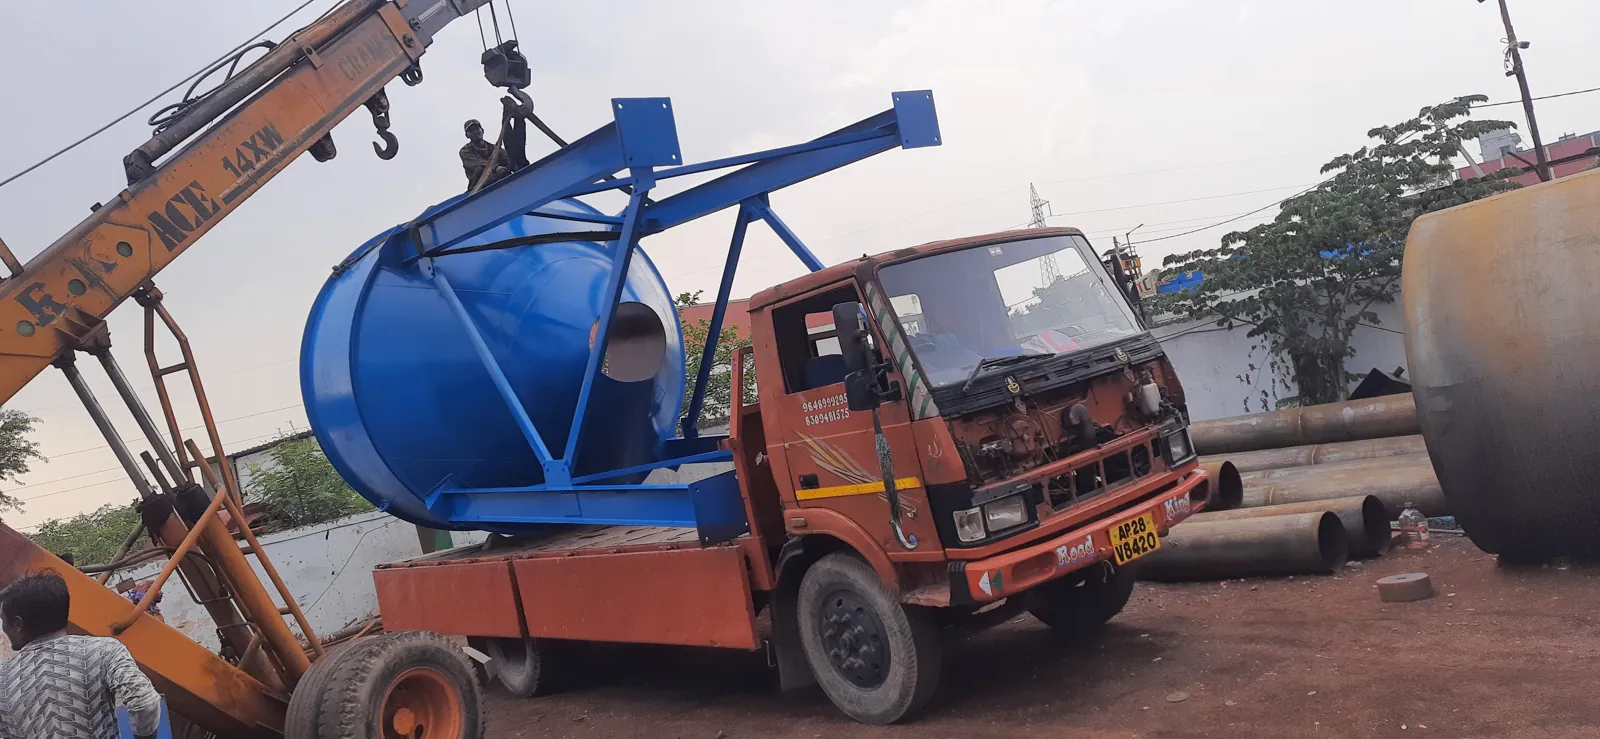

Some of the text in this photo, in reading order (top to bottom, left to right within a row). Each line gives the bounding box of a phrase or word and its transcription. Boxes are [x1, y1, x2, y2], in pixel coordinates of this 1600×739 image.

[148, 180, 221, 252] ACE
[222, 122, 284, 179] 14XW
[1164, 491, 1191, 518] King
[1055, 534, 1095, 567] Road
[1115, 531, 1157, 563] V8420
